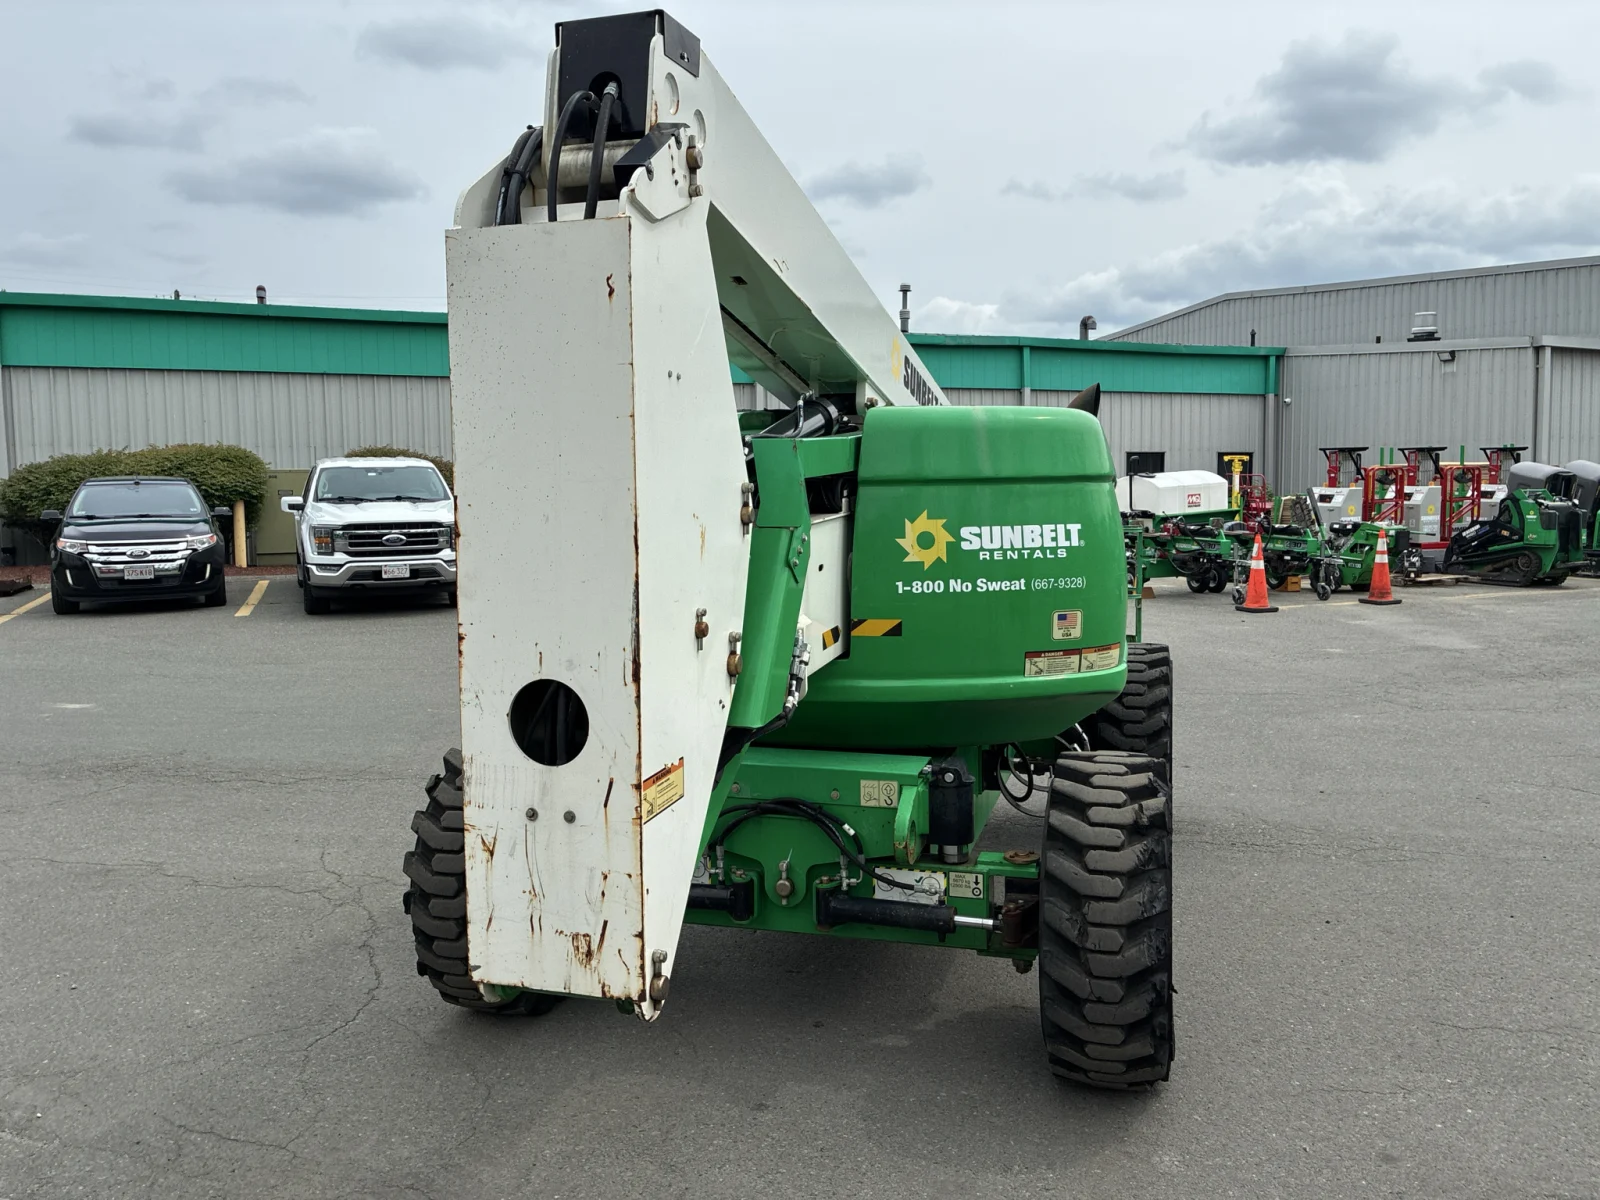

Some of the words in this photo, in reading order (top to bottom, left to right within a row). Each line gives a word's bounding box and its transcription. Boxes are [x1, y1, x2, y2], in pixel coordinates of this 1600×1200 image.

[960, 524, 1081, 550] SUNBELT
[979, 549, 1067, 560] RENTALS
[896, 580, 944, 594] 1-800
[949, 579, 972, 592] No
[976, 578, 1026, 592] Sweat
[1031, 576, 1087, 591] (667-9328)
